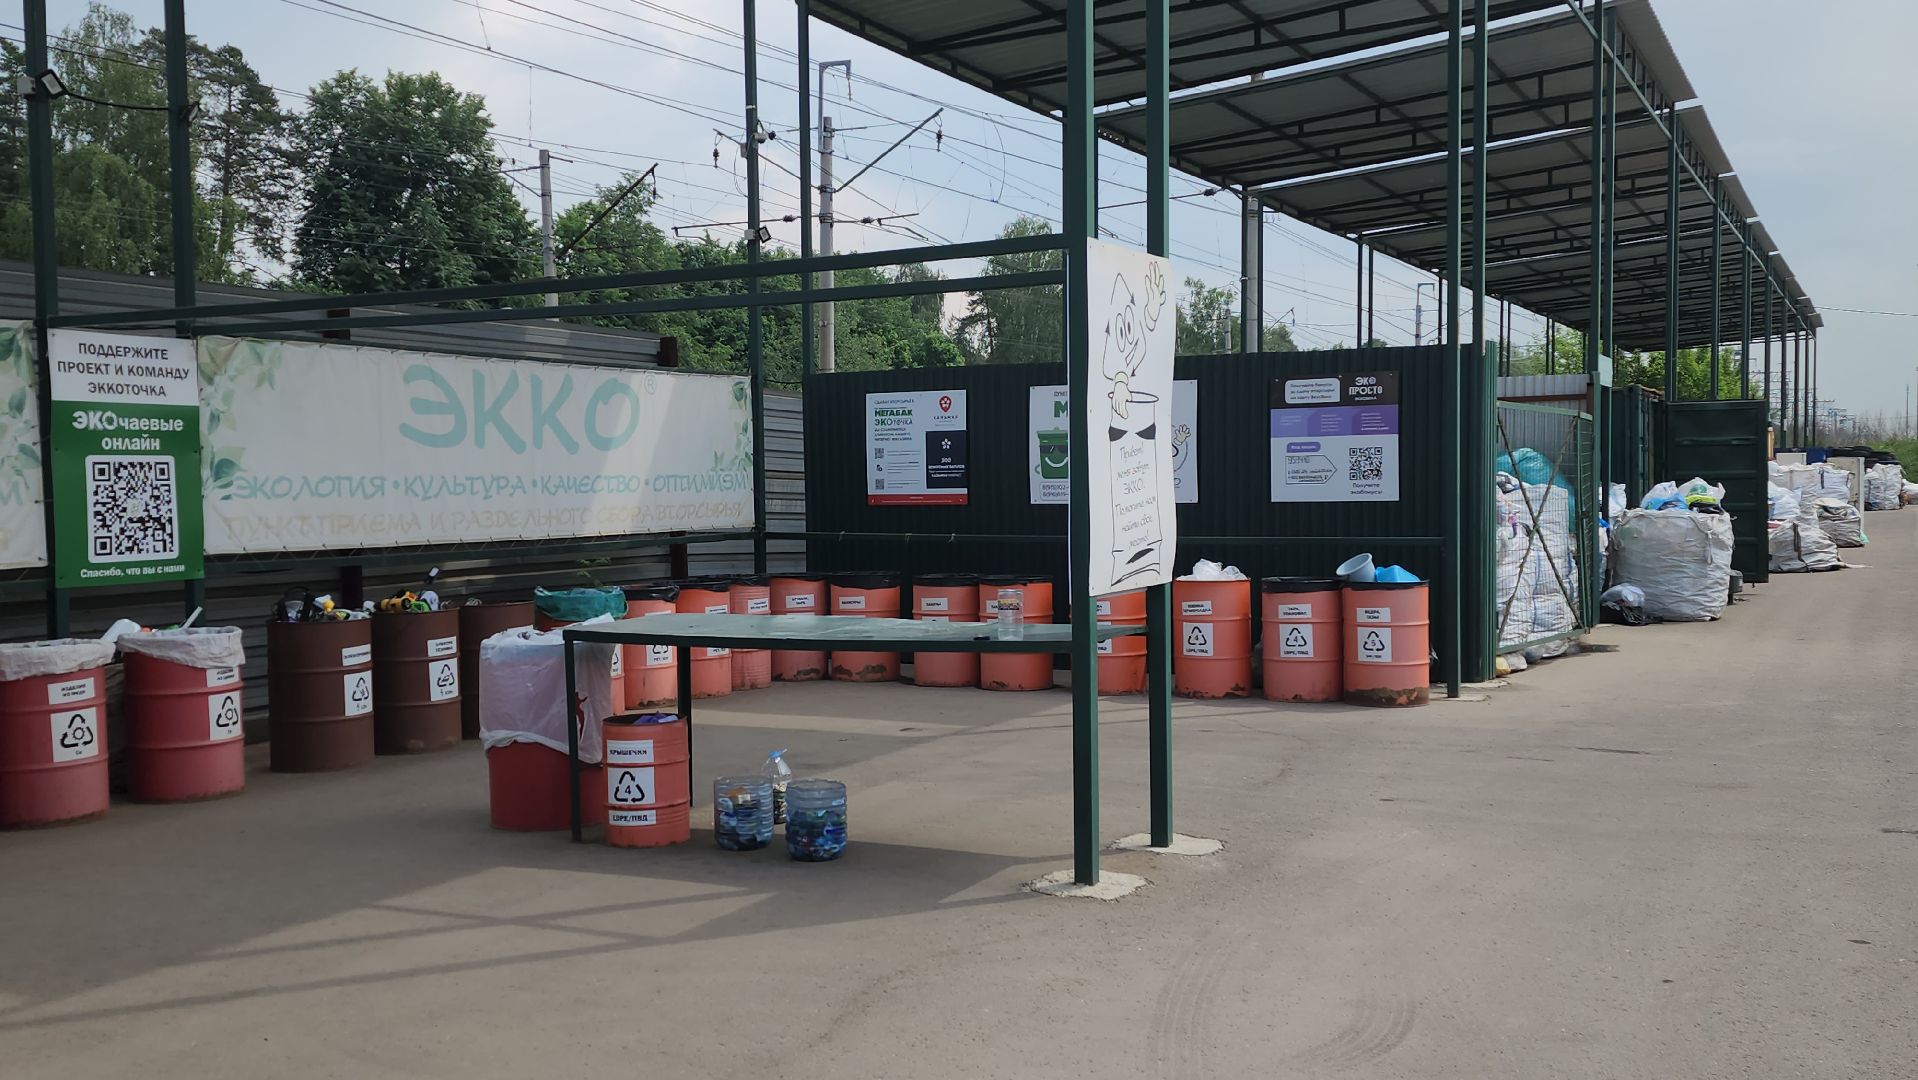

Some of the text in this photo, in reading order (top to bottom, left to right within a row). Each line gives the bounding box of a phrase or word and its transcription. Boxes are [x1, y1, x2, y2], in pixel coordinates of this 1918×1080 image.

[78, 342, 169, 360] ПОДДЕРЖИТЕ
[57, 360, 190, 381] ПРОЕКТ И КОМАНДУ
[87, 381, 167, 398] ЭККОТОЧКА
[1355, 376, 1377, 386] ЭКО
[1348, 386, 1383, 395] ПРОСТО
[398, 363, 641, 456] ЭККО
[71, 410, 184, 431] ЭКОчаевые
[101, 433, 161, 450] онлайн
[232, 472, 748, 501] ЭКОЛОГИЯ КУЛЬТУРА КАЧЕСТВО ОПТИМИЗМ
[227, 515, 313, 540] ПУНКТ
[317, 511, 422, 536] ПРИЕМА
[656, 498, 745, 521] ВТОРСЫРЬЯ
[80, 564, 185, 579] Спасибо, что вы с нами
[1293, 635, 1298, 643] 4
[1370, 639, 1376, 647] 5
[624, 785, 632, 795] 4
